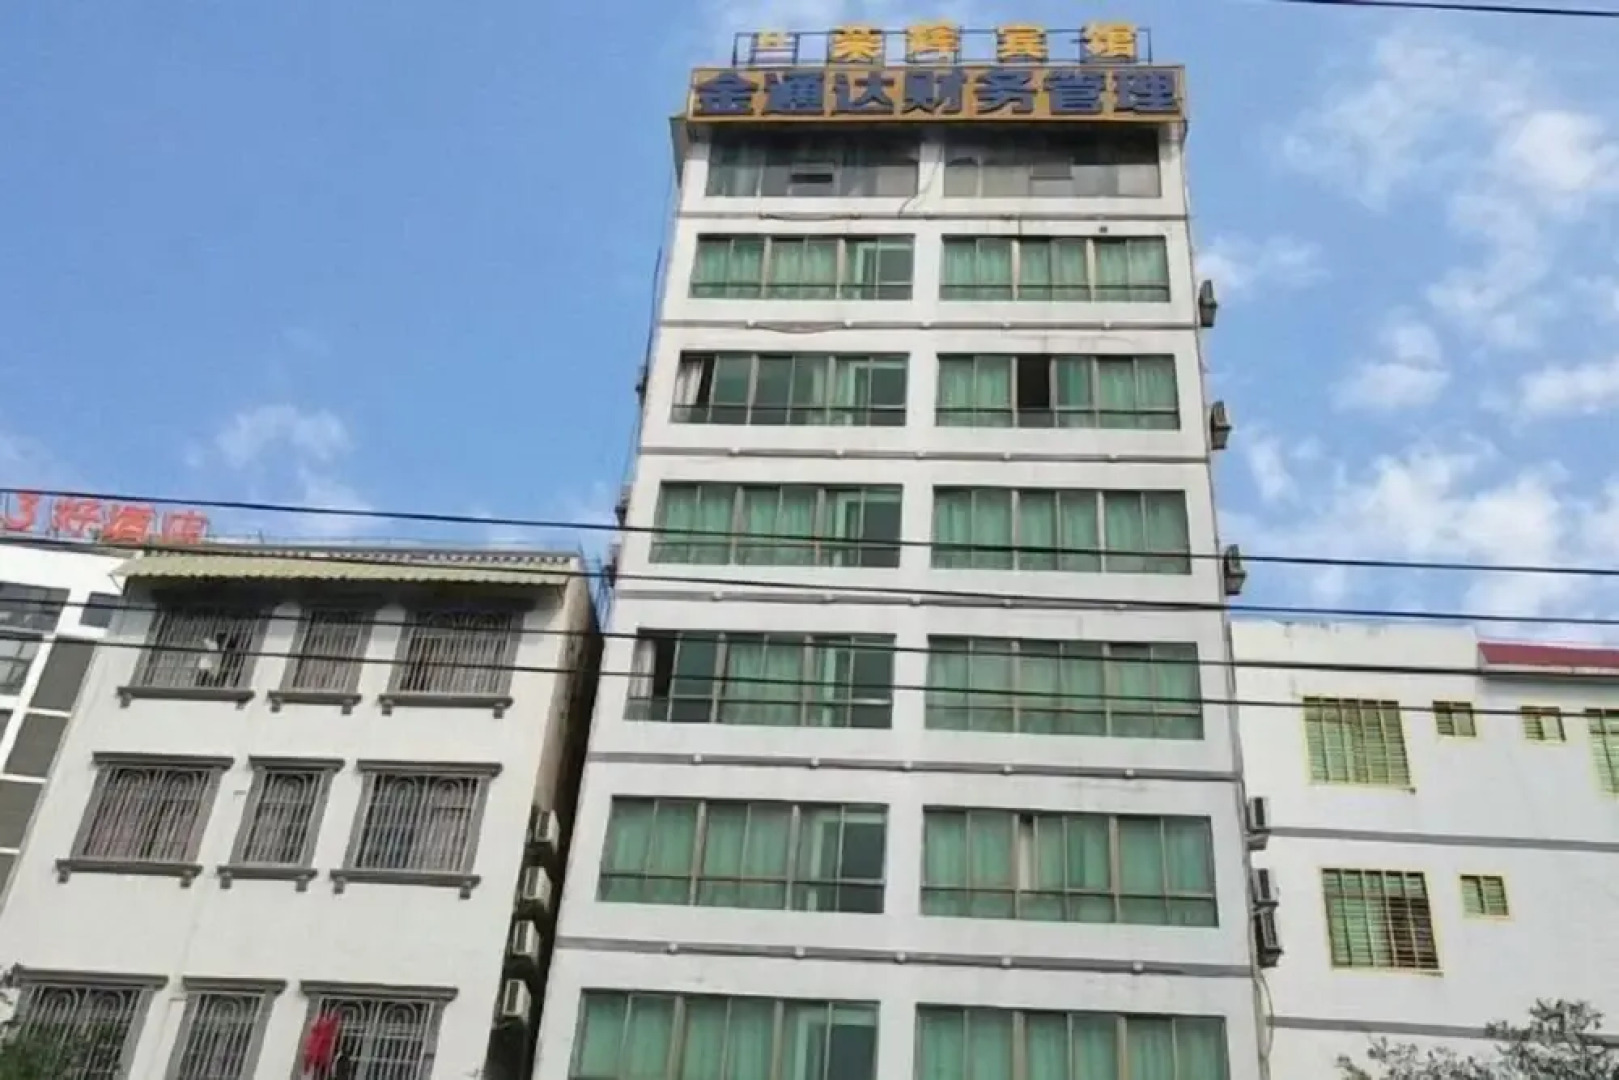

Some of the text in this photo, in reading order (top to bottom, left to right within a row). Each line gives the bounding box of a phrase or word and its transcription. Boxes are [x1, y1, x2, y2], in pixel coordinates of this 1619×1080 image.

[694, 69, 1181, 115] 金通达财务管理
